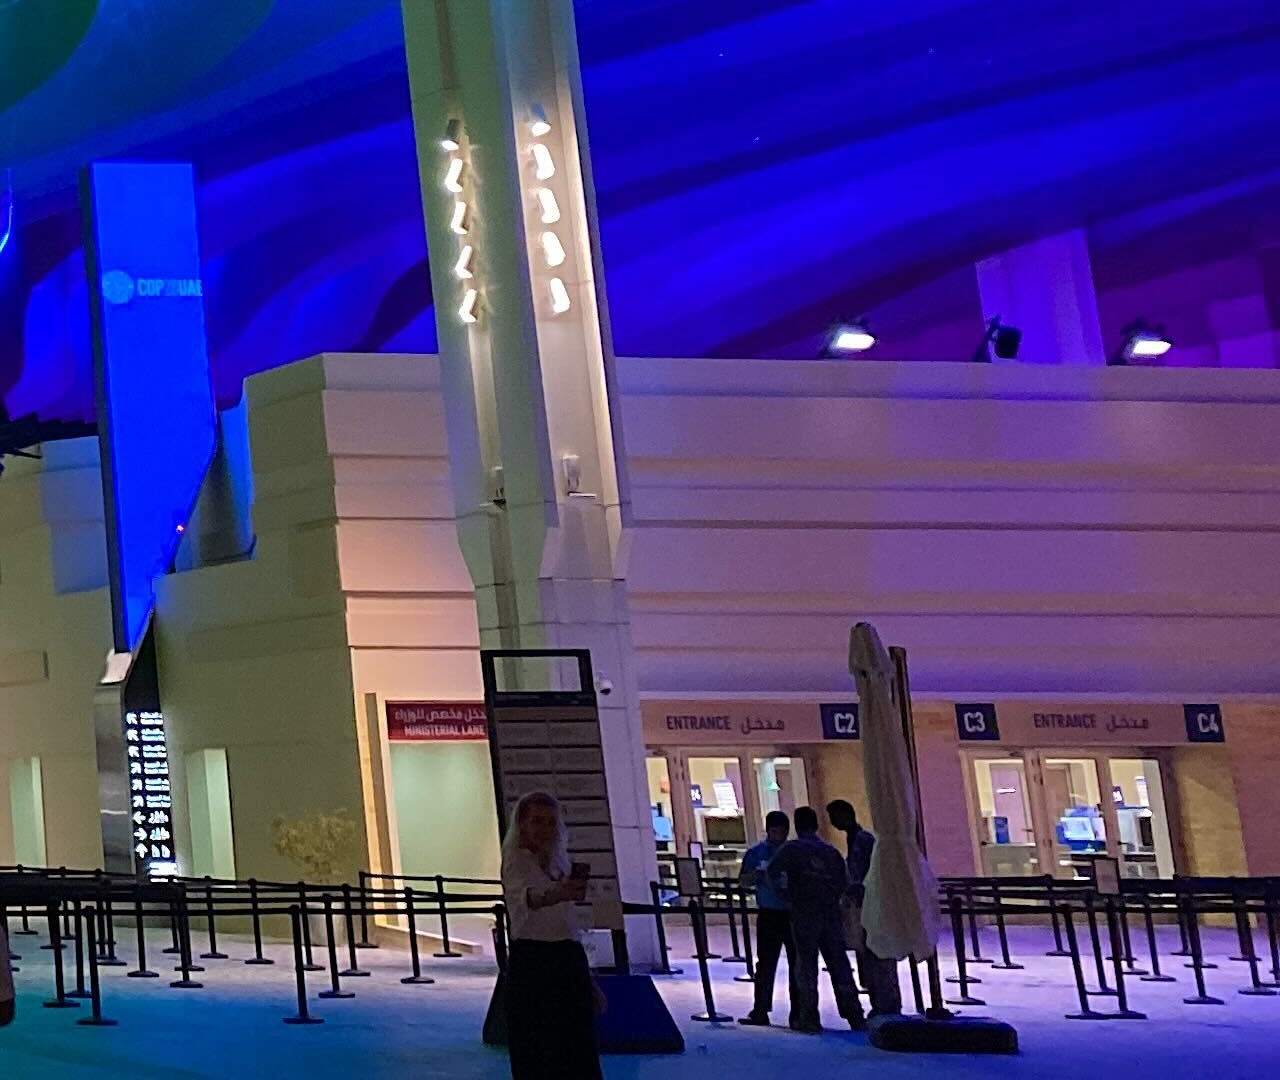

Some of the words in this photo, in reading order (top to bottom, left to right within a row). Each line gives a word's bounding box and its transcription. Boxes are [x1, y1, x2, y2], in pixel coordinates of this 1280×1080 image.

[404, 724, 461, 736] MINISTERIAL
[461, 724, 486, 736] LANE
[666, 716, 732, 731] ENTRANCE
[741, 716, 785, 735] مدخل
[834, 713, 857, 734] C2
[963, 712, 985, 733] C3
[1033, 713, 1097, 729] ENTRANCE
[1106, 714, 1149, 733] مدخل
[1197, 713, 1220, 734] C4
